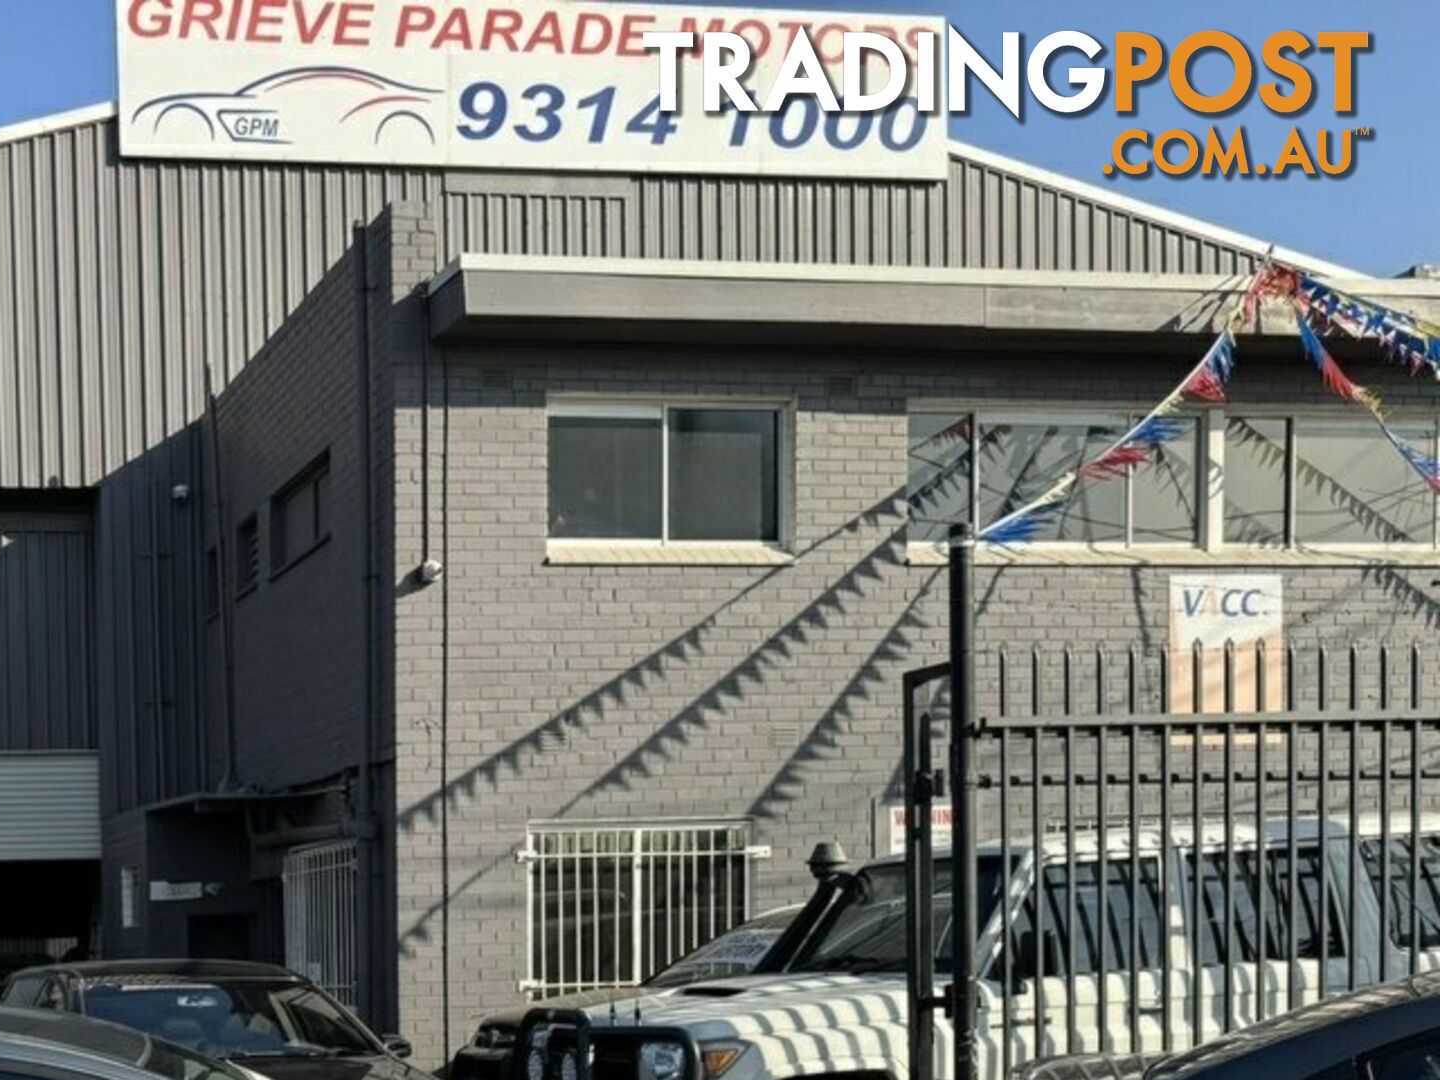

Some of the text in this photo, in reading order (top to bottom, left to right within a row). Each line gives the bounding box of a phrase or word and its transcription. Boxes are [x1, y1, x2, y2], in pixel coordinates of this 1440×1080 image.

[127, 0, 375, 47] GRIEVE
[394, 6, 657, 57] PARADE
[233, 116, 280, 138] GPM
[456, 81, 929, 151] 9314 1000
